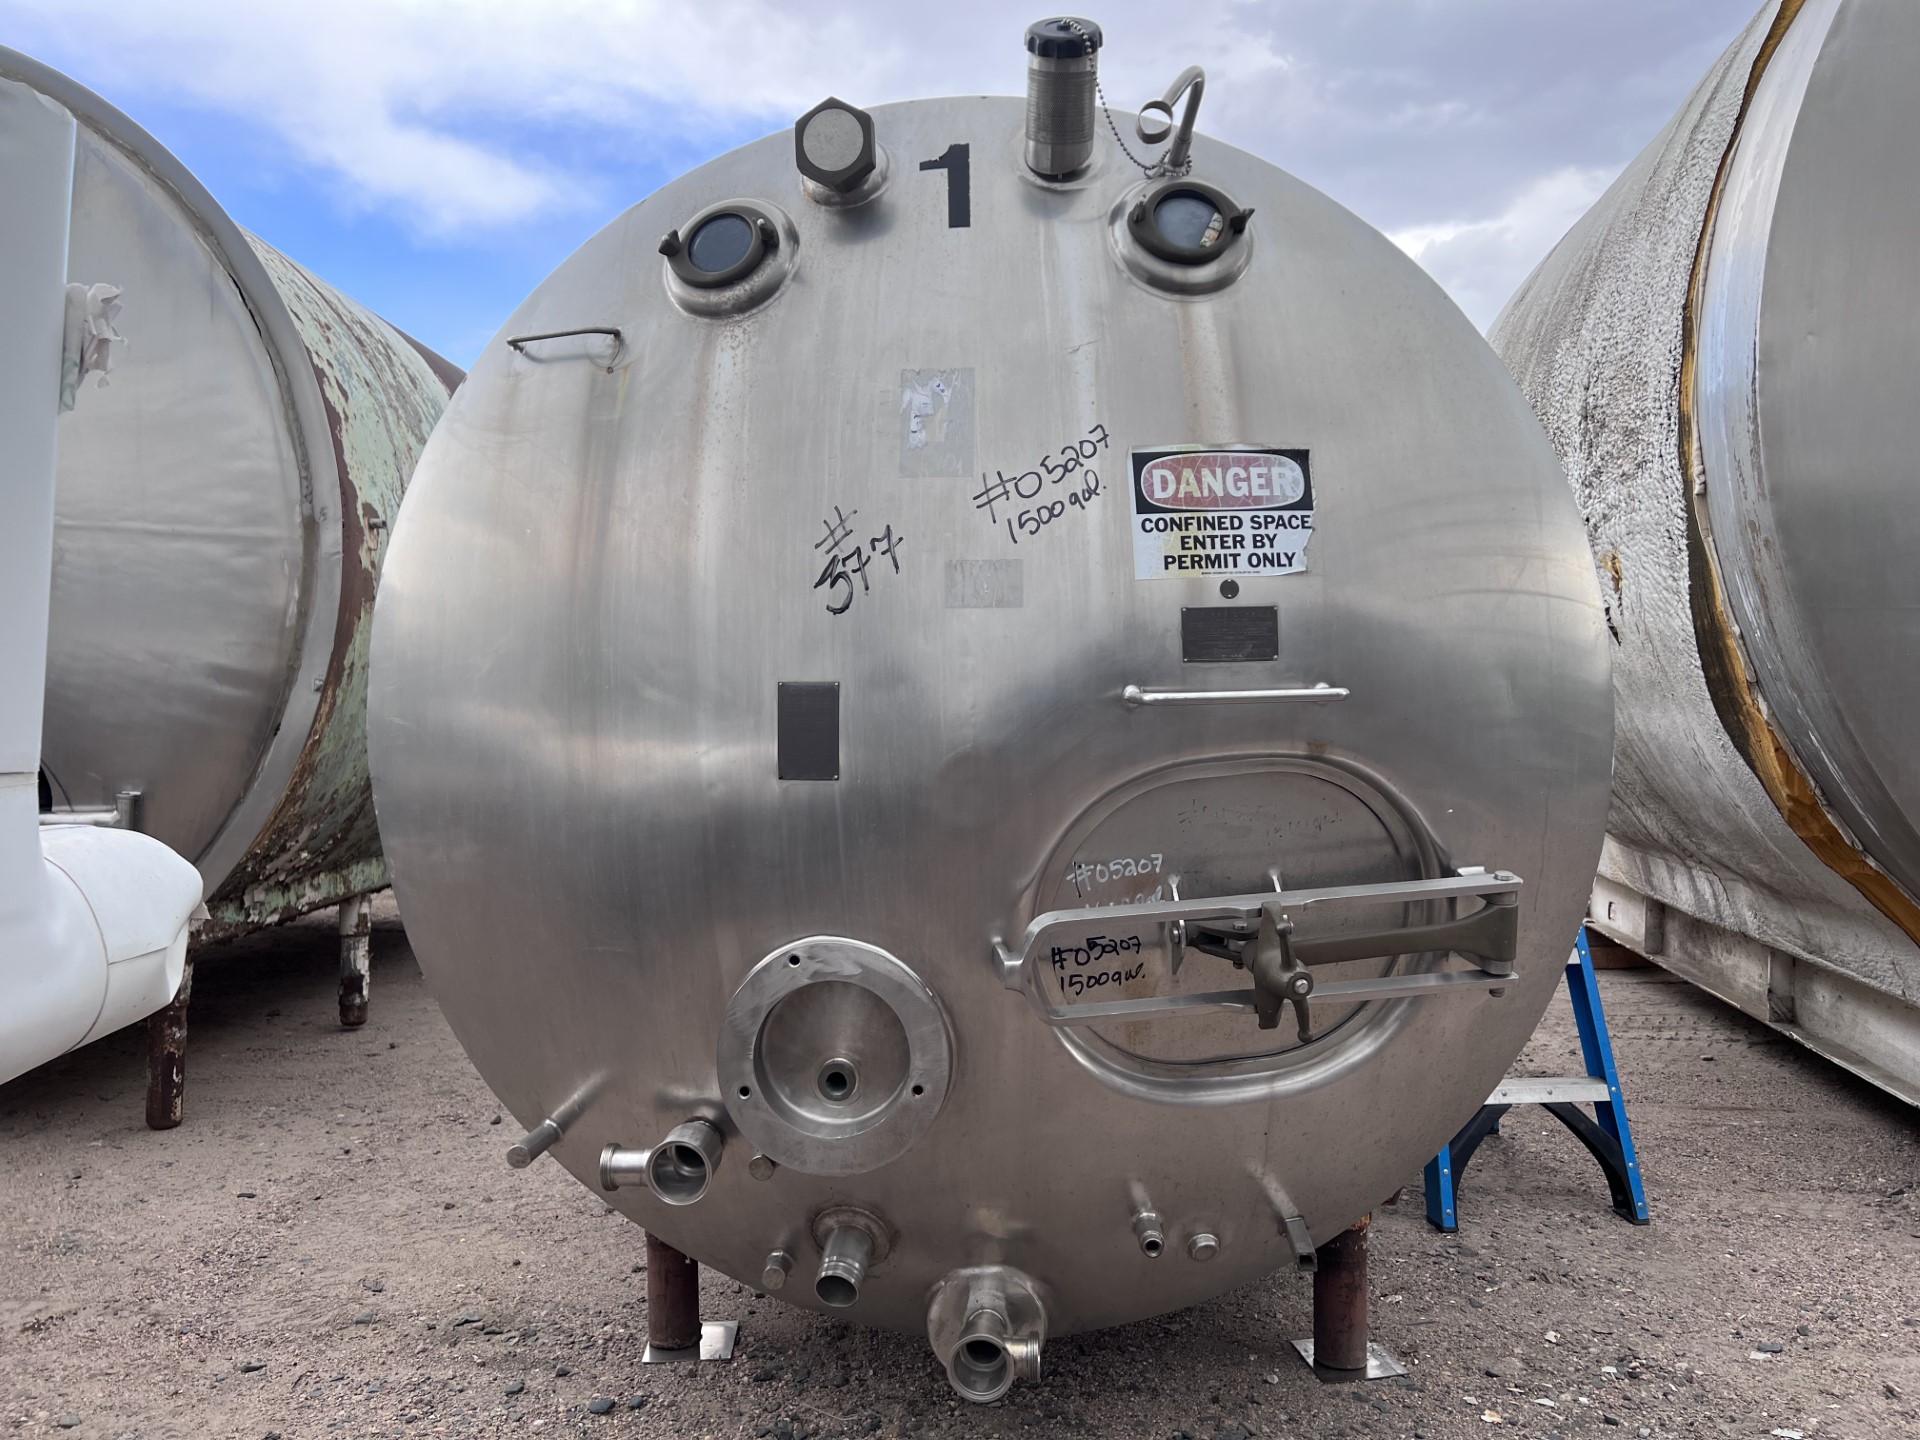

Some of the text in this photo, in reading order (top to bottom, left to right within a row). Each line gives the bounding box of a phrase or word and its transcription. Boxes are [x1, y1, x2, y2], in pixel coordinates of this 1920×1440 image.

[919, 142, 971, 229] 1
[973, 424, 1110, 524] #05207
[1151, 466, 1295, 499] DANGER
[1140, 513, 1312, 533] CONFINED SPACE
[1180, 533, 1278, 551] ENTER BY
[1163, 551, 1297, 571] PERMIT ONLY
[1066, 853, 1163, 898] #05207
[1051, 935, 1142, 971] #05207
